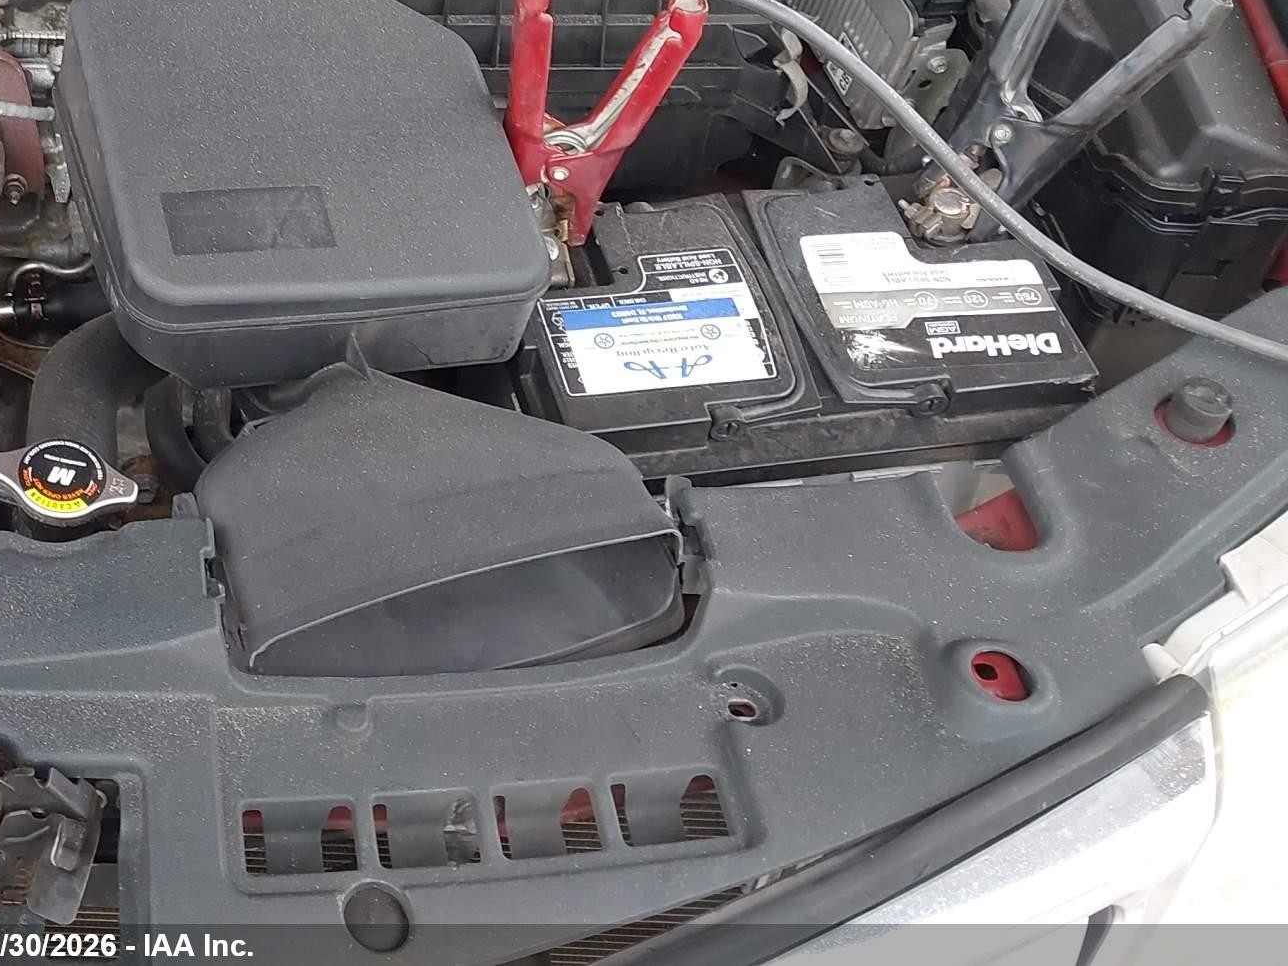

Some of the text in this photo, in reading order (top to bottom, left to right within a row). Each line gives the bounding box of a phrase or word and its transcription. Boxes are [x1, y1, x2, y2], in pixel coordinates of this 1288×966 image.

[918, 296, 934, 307] 70
[963, 294, 986, 304] 120
[1015, 291, 1039, 302] 760
[839, 313, 898, 324] PLATINUM
[929, 325, 958, 333] AGM
[929, 332, 1062, 358] DieHard
[46, 465, 76, 487] M
[30, 491, 72, 510] CAUTION
